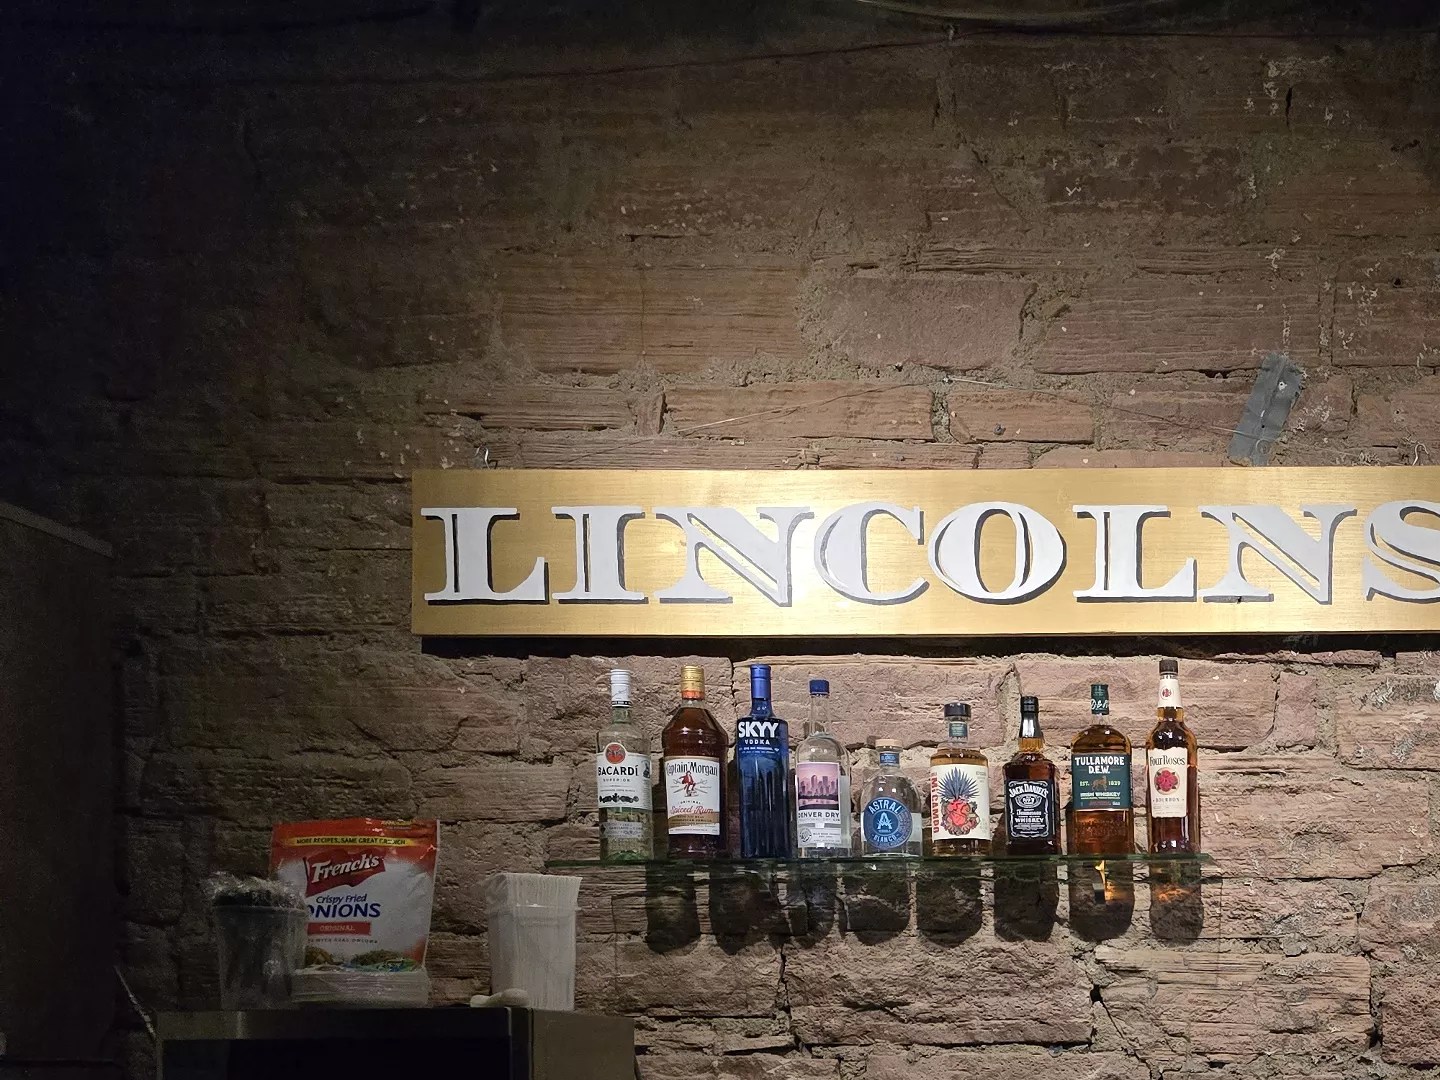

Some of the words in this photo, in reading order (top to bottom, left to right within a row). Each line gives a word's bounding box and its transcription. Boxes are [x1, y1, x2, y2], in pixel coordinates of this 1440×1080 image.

[738, 721, 779, 738] SKYY
[1074, 756, 1125, 766] TULLAMORE
[1162, 755, 1186, 766] Roses
[689, 761, 718, 777] Morgan
[1088, 766, 1111, 775] D.E.W.
[1008, 786, 1025, 797] JACK
[868, 799, 902, 815] ASTRAL
[310, 853, 380, 884] French's
[316, 895, 343, 904] Crispy
[345, 893, 367, 902] Fried
